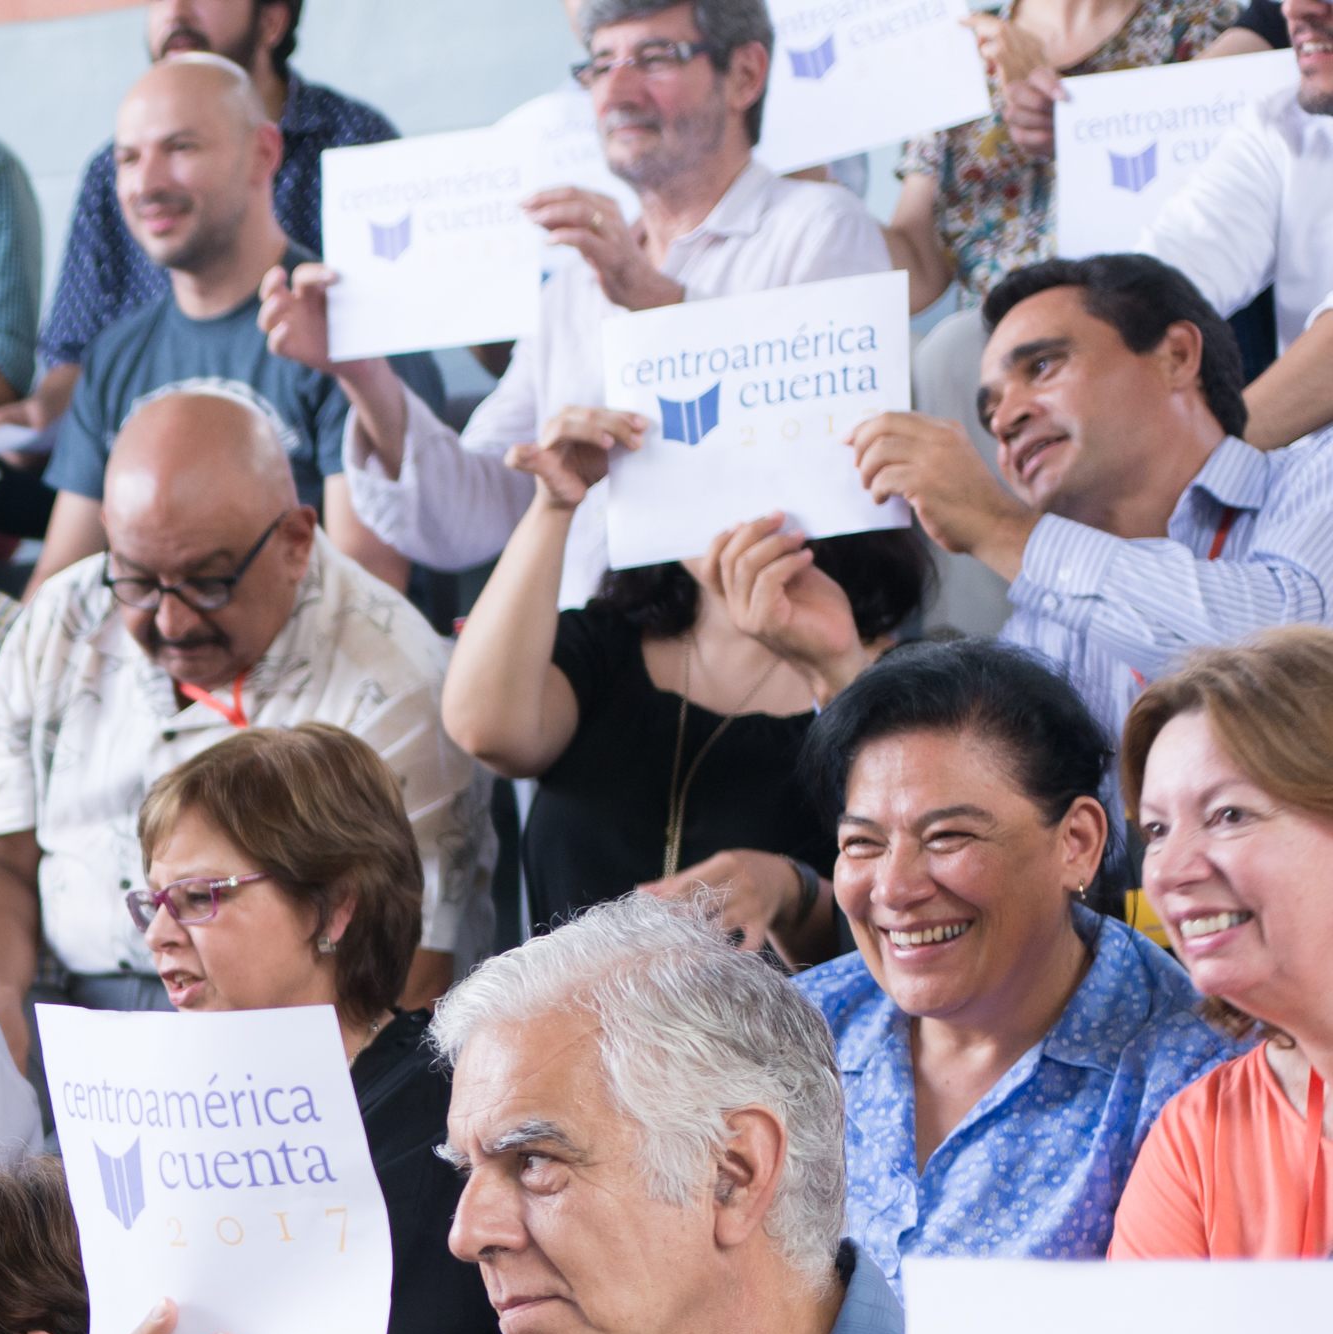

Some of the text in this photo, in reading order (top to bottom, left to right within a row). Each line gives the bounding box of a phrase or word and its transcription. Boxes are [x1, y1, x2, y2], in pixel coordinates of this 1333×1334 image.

[1074, 90, 1245, 143] centroamér
[621, 320, 878, 388] centroamérica
[739, 363, 880, 408] cuenta
[740, 408, 879, 447] 201
[63, 1073, 323, 1128] centroamérica
[159, 1139, 339, 1190] cuenta
[166, 1207, 347, 1252] 2017
